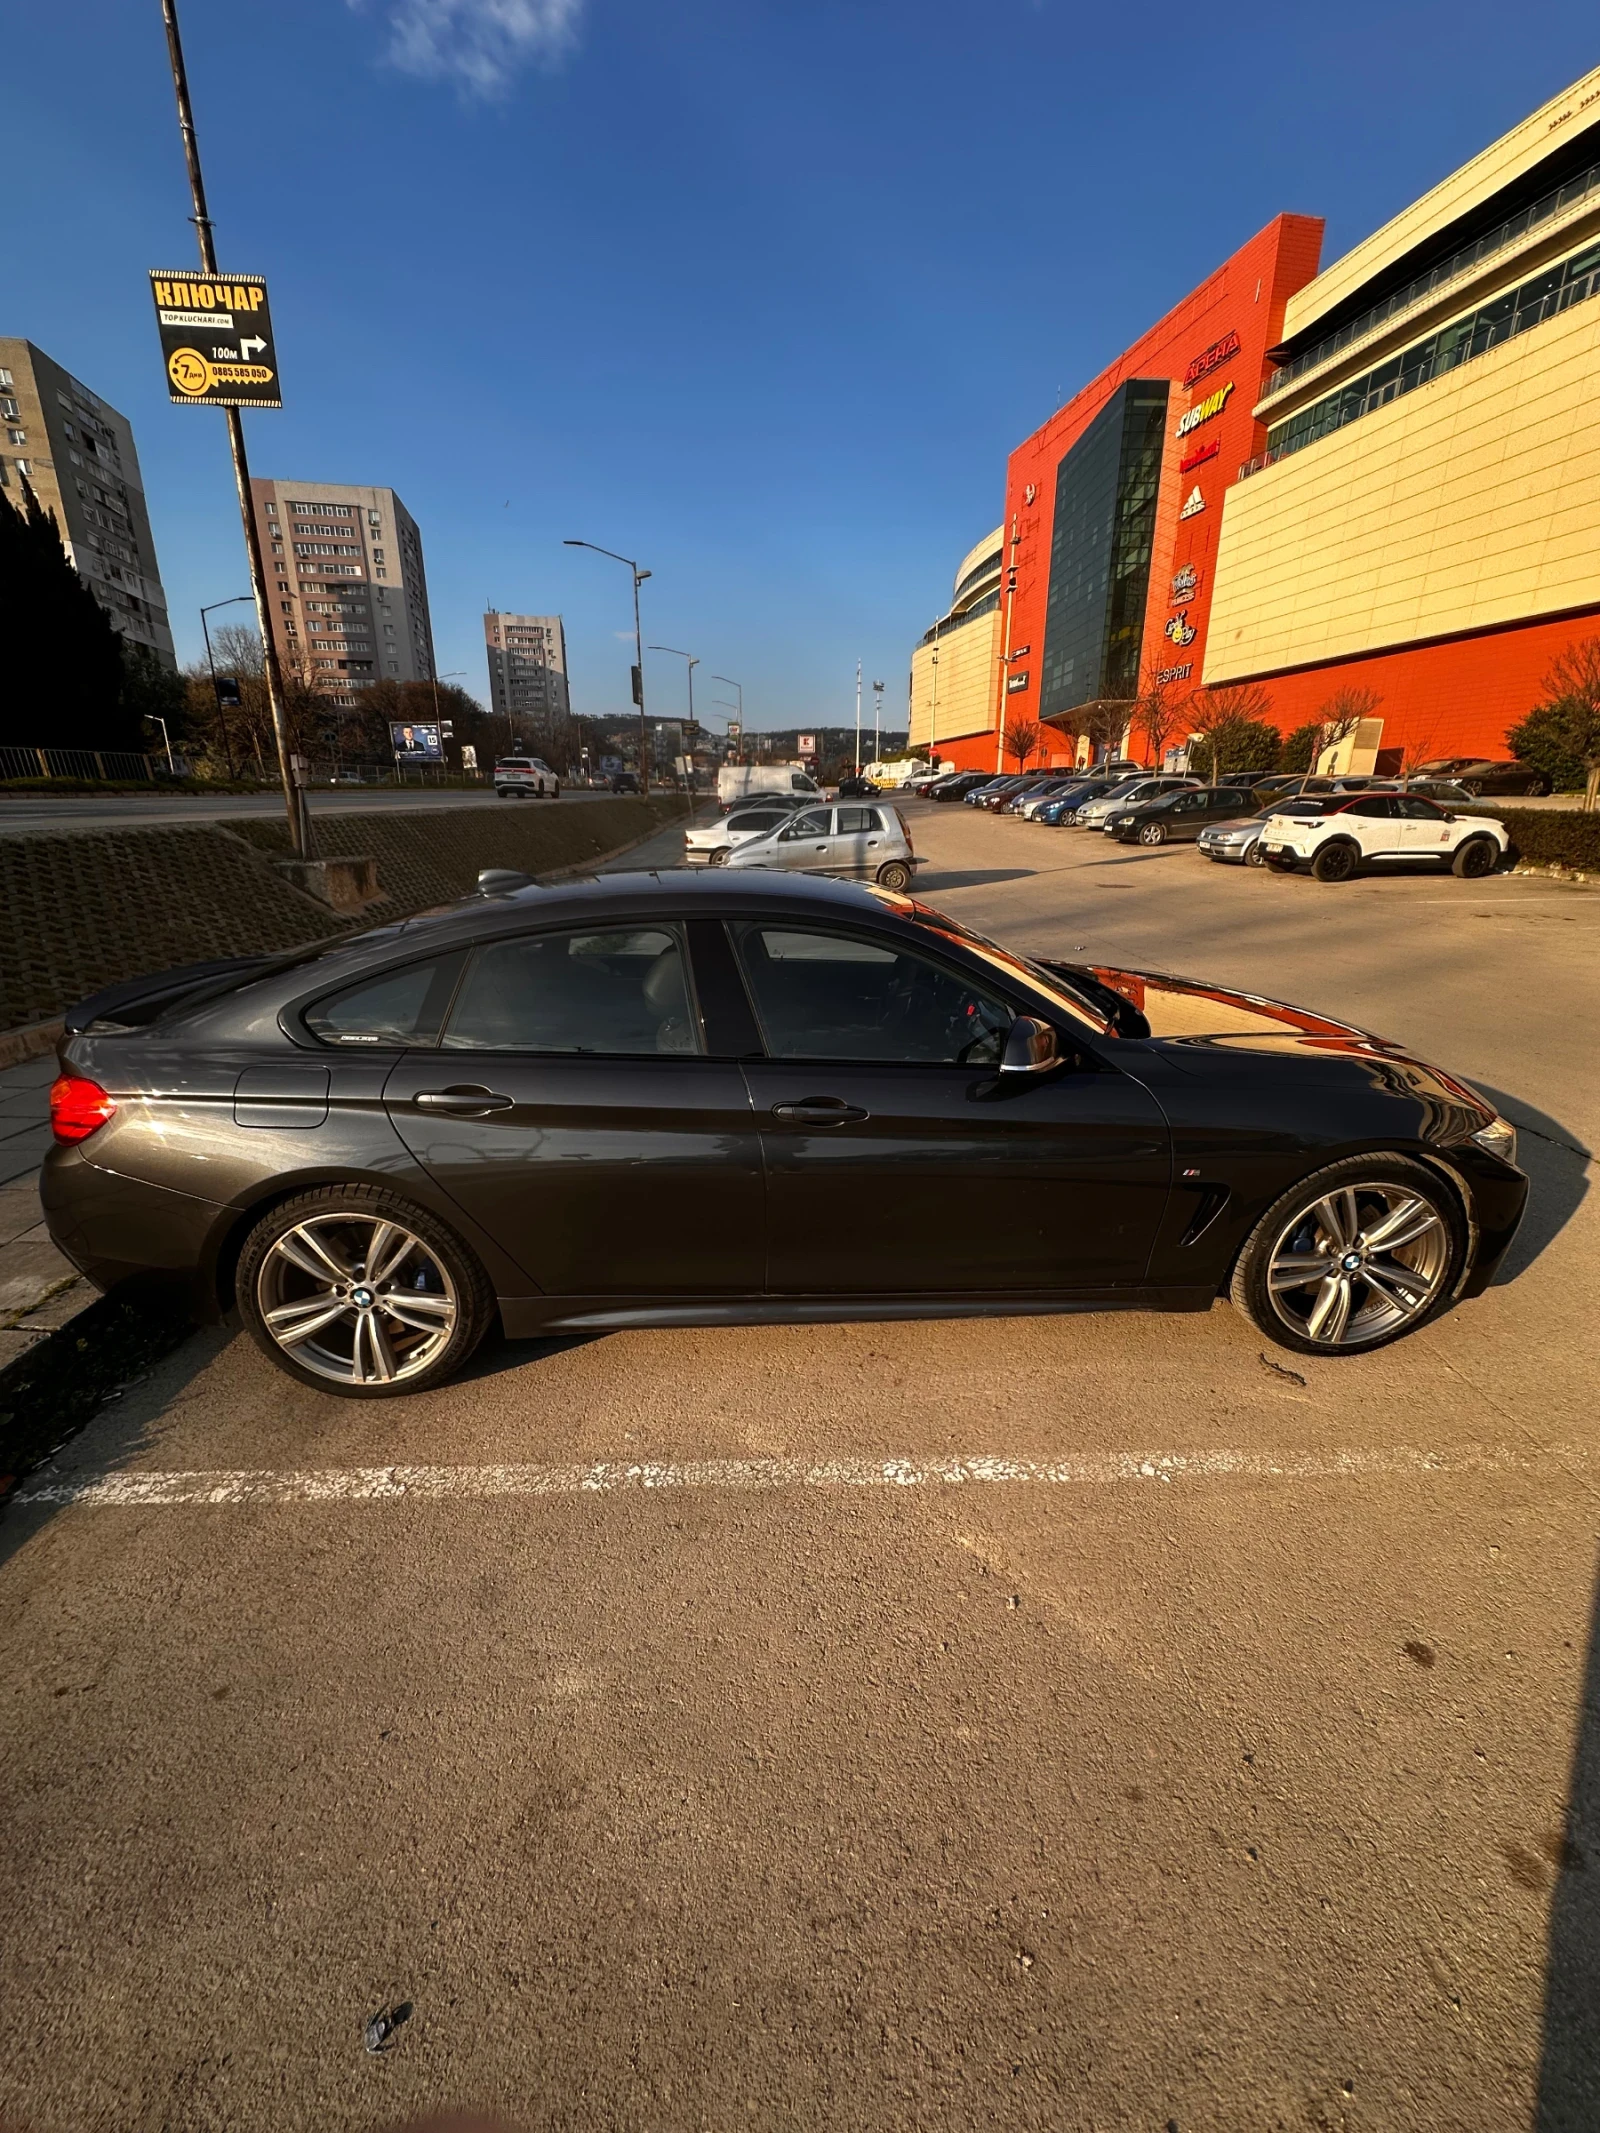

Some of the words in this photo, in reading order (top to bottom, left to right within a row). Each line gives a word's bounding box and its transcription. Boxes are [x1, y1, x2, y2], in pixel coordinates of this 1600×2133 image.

[154, 281, 264, 311] КЛЮЧАР
[180, 364, 189, 379] 7
[212, 366, 233, 377] 0885
[234, 367, 250, 378] 585
[251, 368, 267, 379] 050
[1175, 381, 1234, 439] SUBWAY
[1157, 663, 1192, 684] ESPRIT
